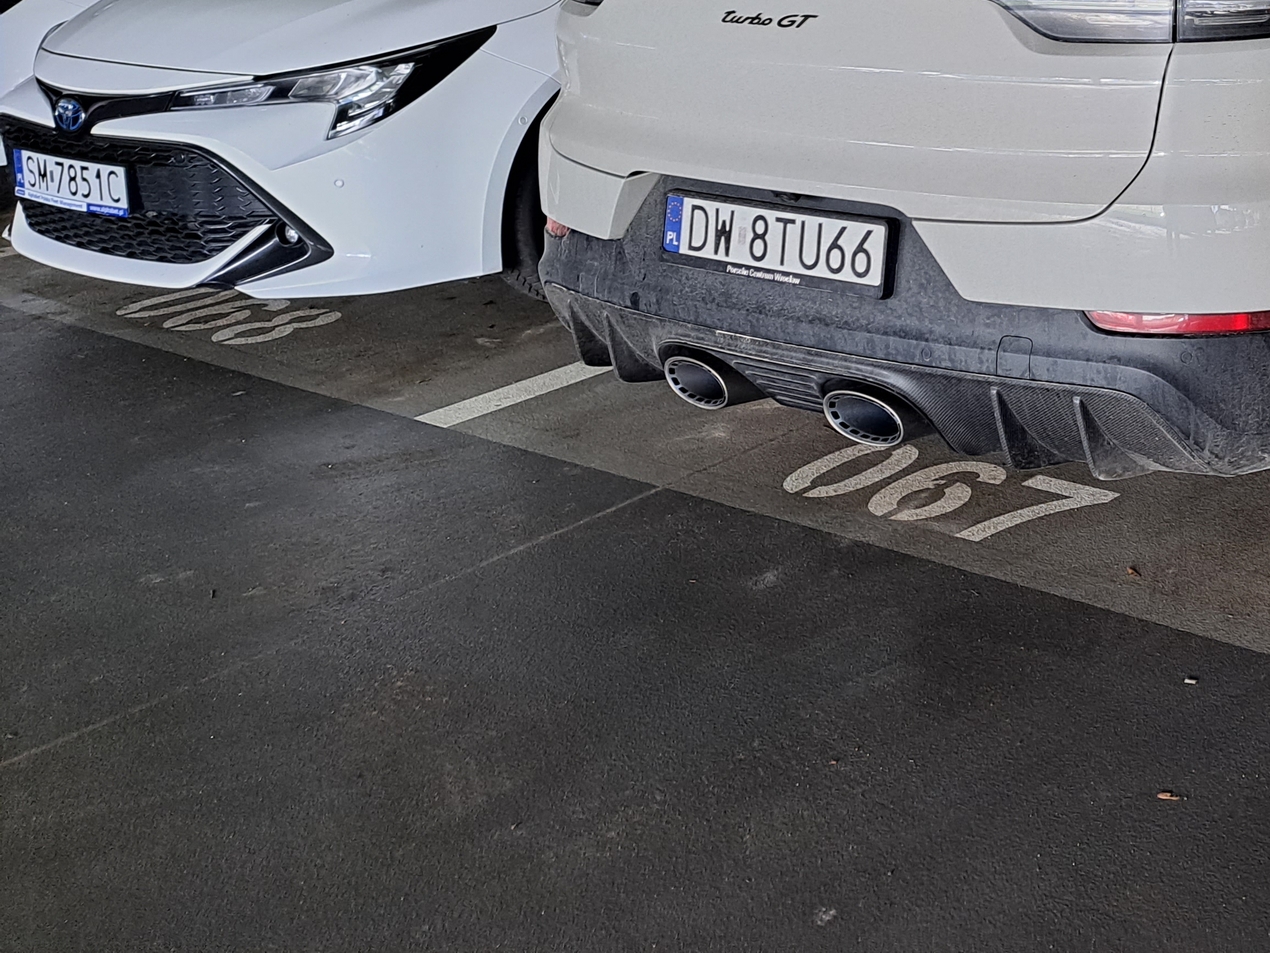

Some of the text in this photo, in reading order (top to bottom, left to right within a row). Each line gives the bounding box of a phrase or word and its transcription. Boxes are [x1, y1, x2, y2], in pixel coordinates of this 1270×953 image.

[777, 14, 819, 28] GT
[26, 156, 121, 203] SM 7851C
[666, 231, 679, 245] PL
[687, 204, 874, 278] DW 8TU66
[726, 265, 749, 276] Porsche
[749, 269, 774, 280] Centrum
[116, 286, 342, 345] 068
[783, 444, 1121, 541] 067
